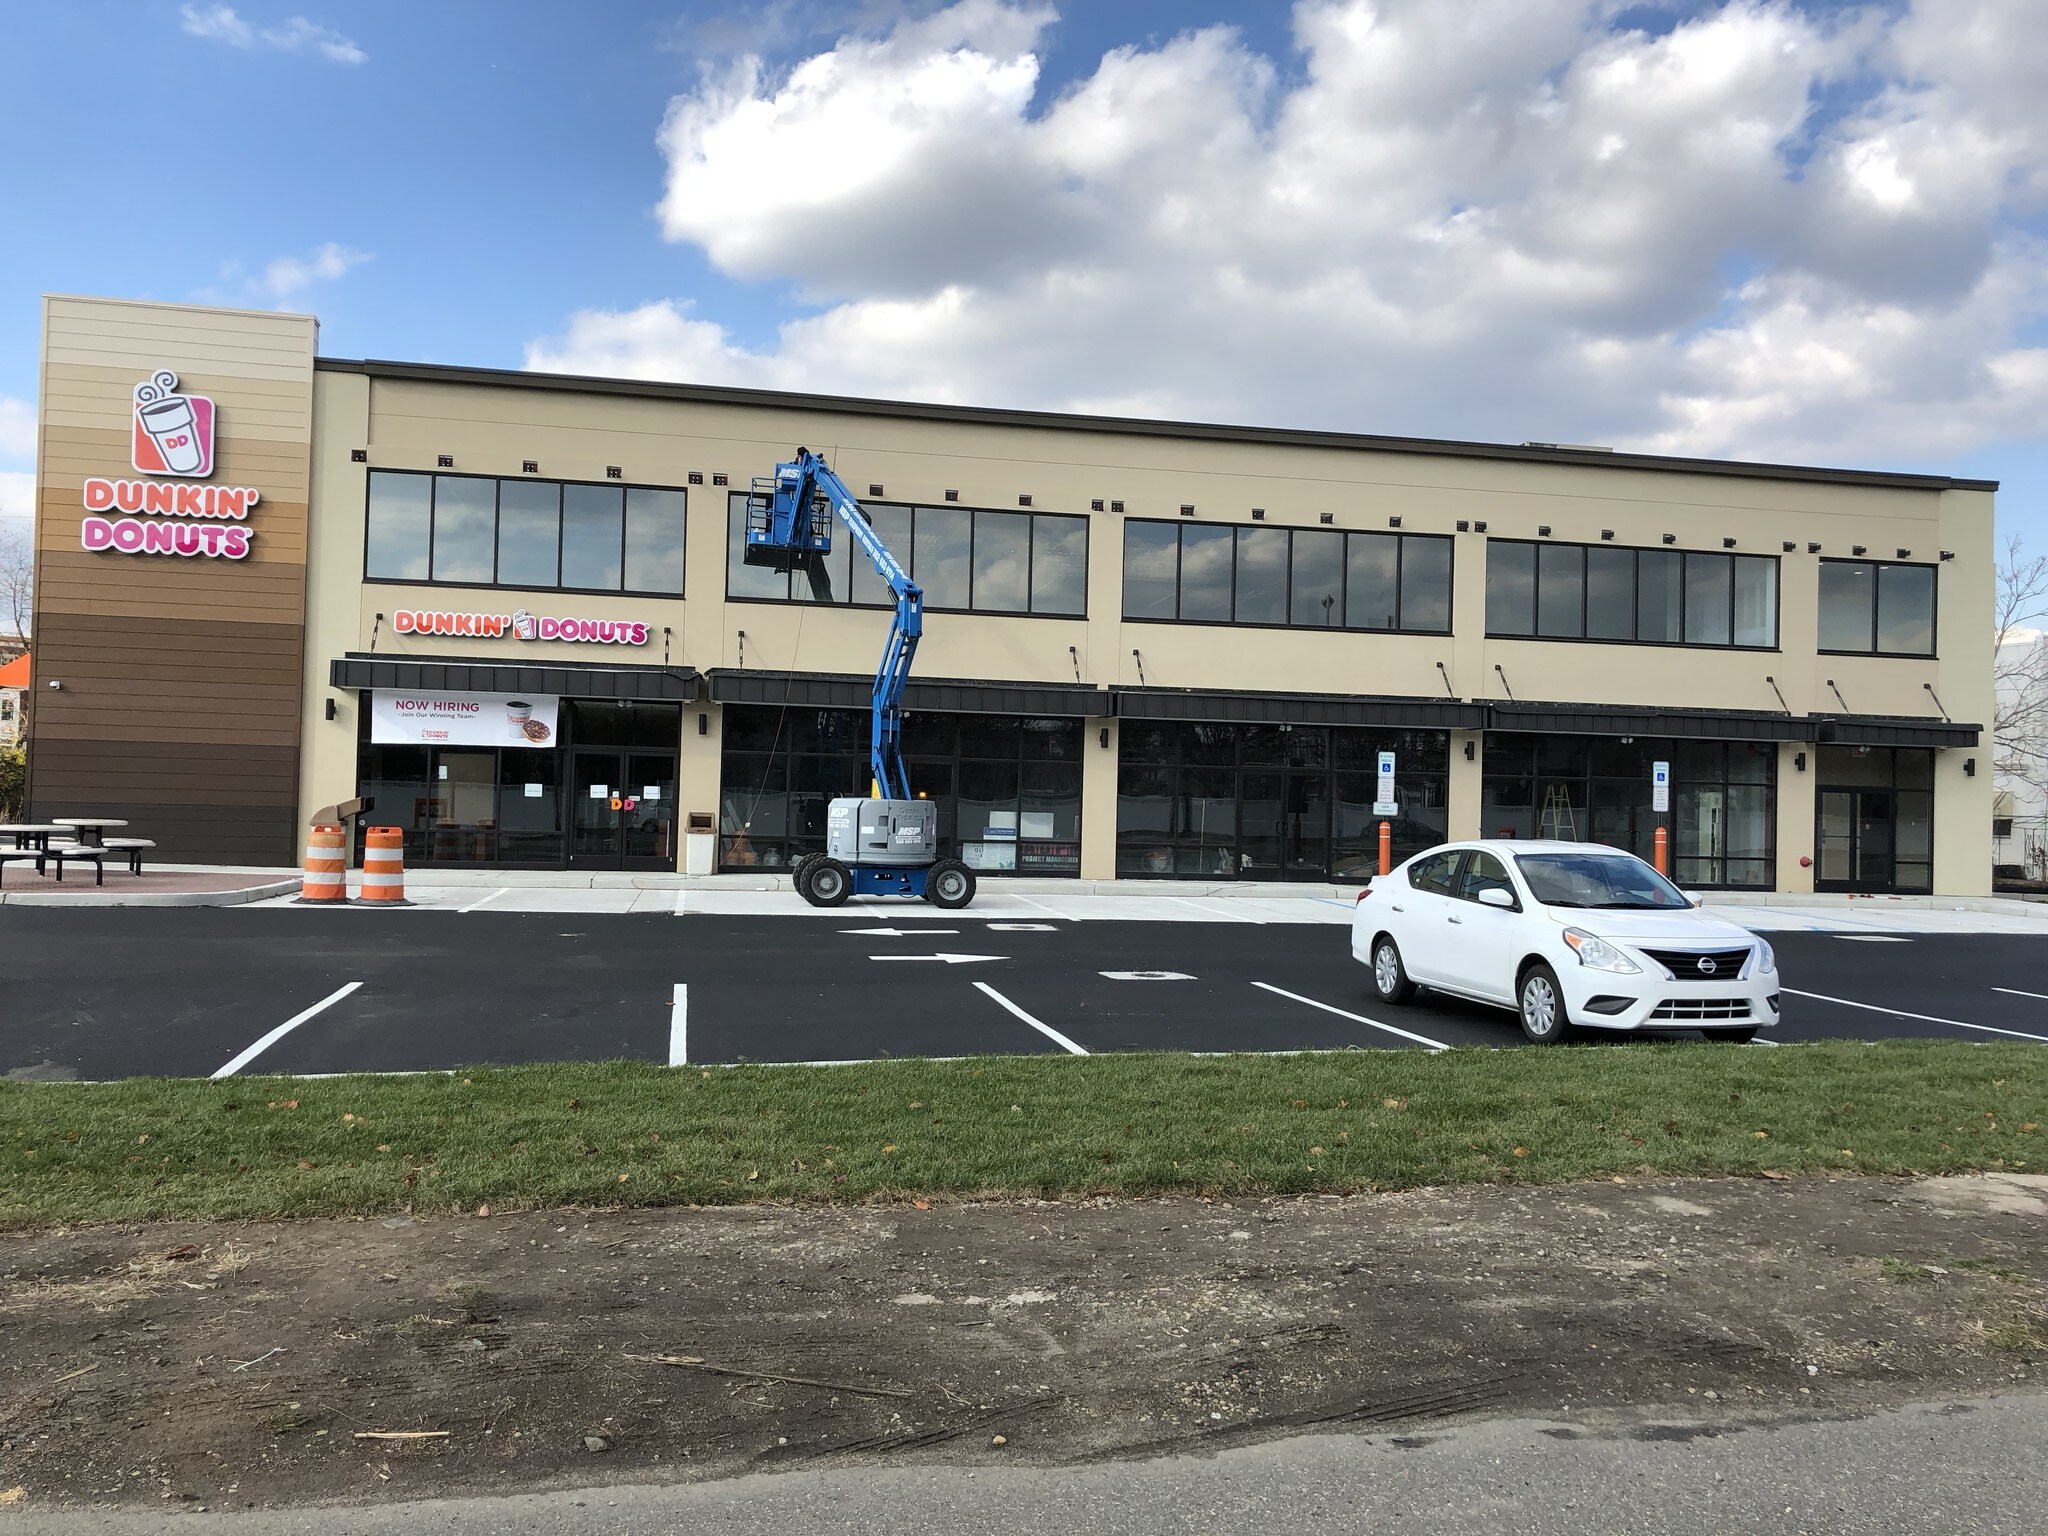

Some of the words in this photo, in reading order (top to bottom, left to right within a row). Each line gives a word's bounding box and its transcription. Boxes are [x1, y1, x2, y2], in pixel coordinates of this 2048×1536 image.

[165, 434, 189, 449] DD
[86, 479, 258, 517] DUNKIN'
[84, 519, 248, 557] DONUTS
[396, 611, 510, 637] DUNKIN'
[541, 618, 647, 643] DONUTS
[395, 700, 429, 711] NOW
[433, 701, 480, 712] HIRING
[429, 712, 455, 720] Winning
[830, 807, 849, 818] MSP
[897, 827, 921, 836] MSP
[1021, 855, 1045, 863] PROJECT
